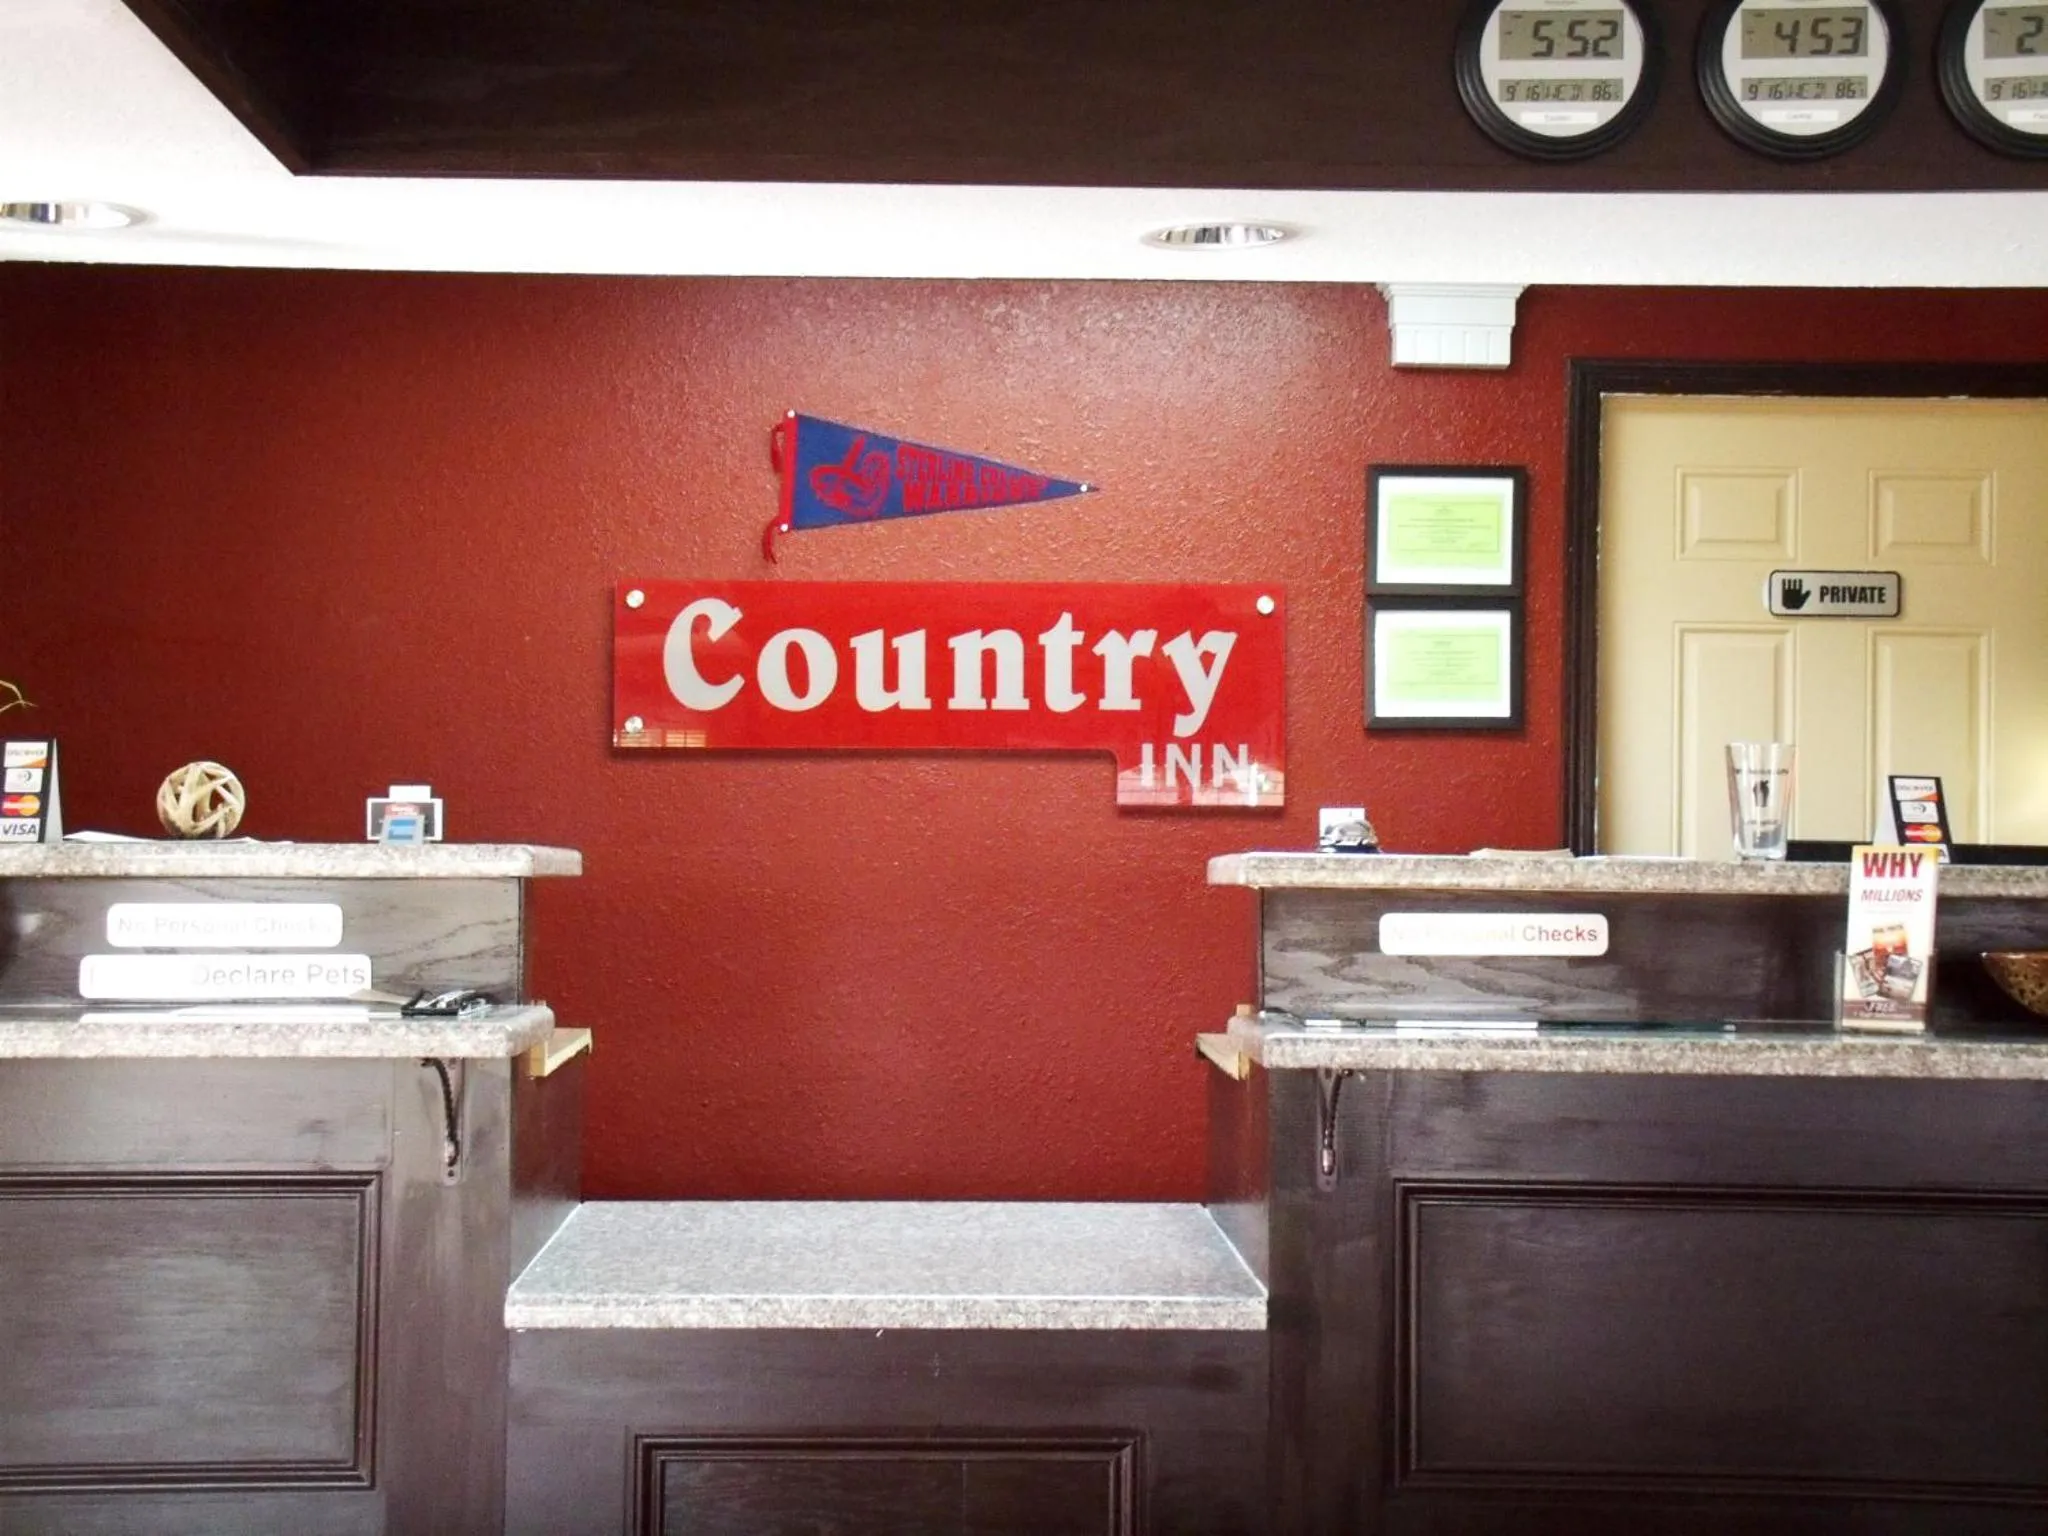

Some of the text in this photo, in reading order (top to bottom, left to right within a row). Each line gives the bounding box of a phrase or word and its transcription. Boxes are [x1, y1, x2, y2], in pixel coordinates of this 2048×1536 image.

[1819, 585, 1887, 604] PRIVATE
[663, 597, 1238, 738] Country
[1142, 743, 1250, 788] INN
[2, 823, 37, 835] VISA
[1862, 851, 1925, 879] WHY
[1861, 888, 1924, 903] MILLIONS
[1522, 924, 1599, 943] Checks
[193, 963, 296, 986] Declare
[307, 963, 367, 986] Pets
